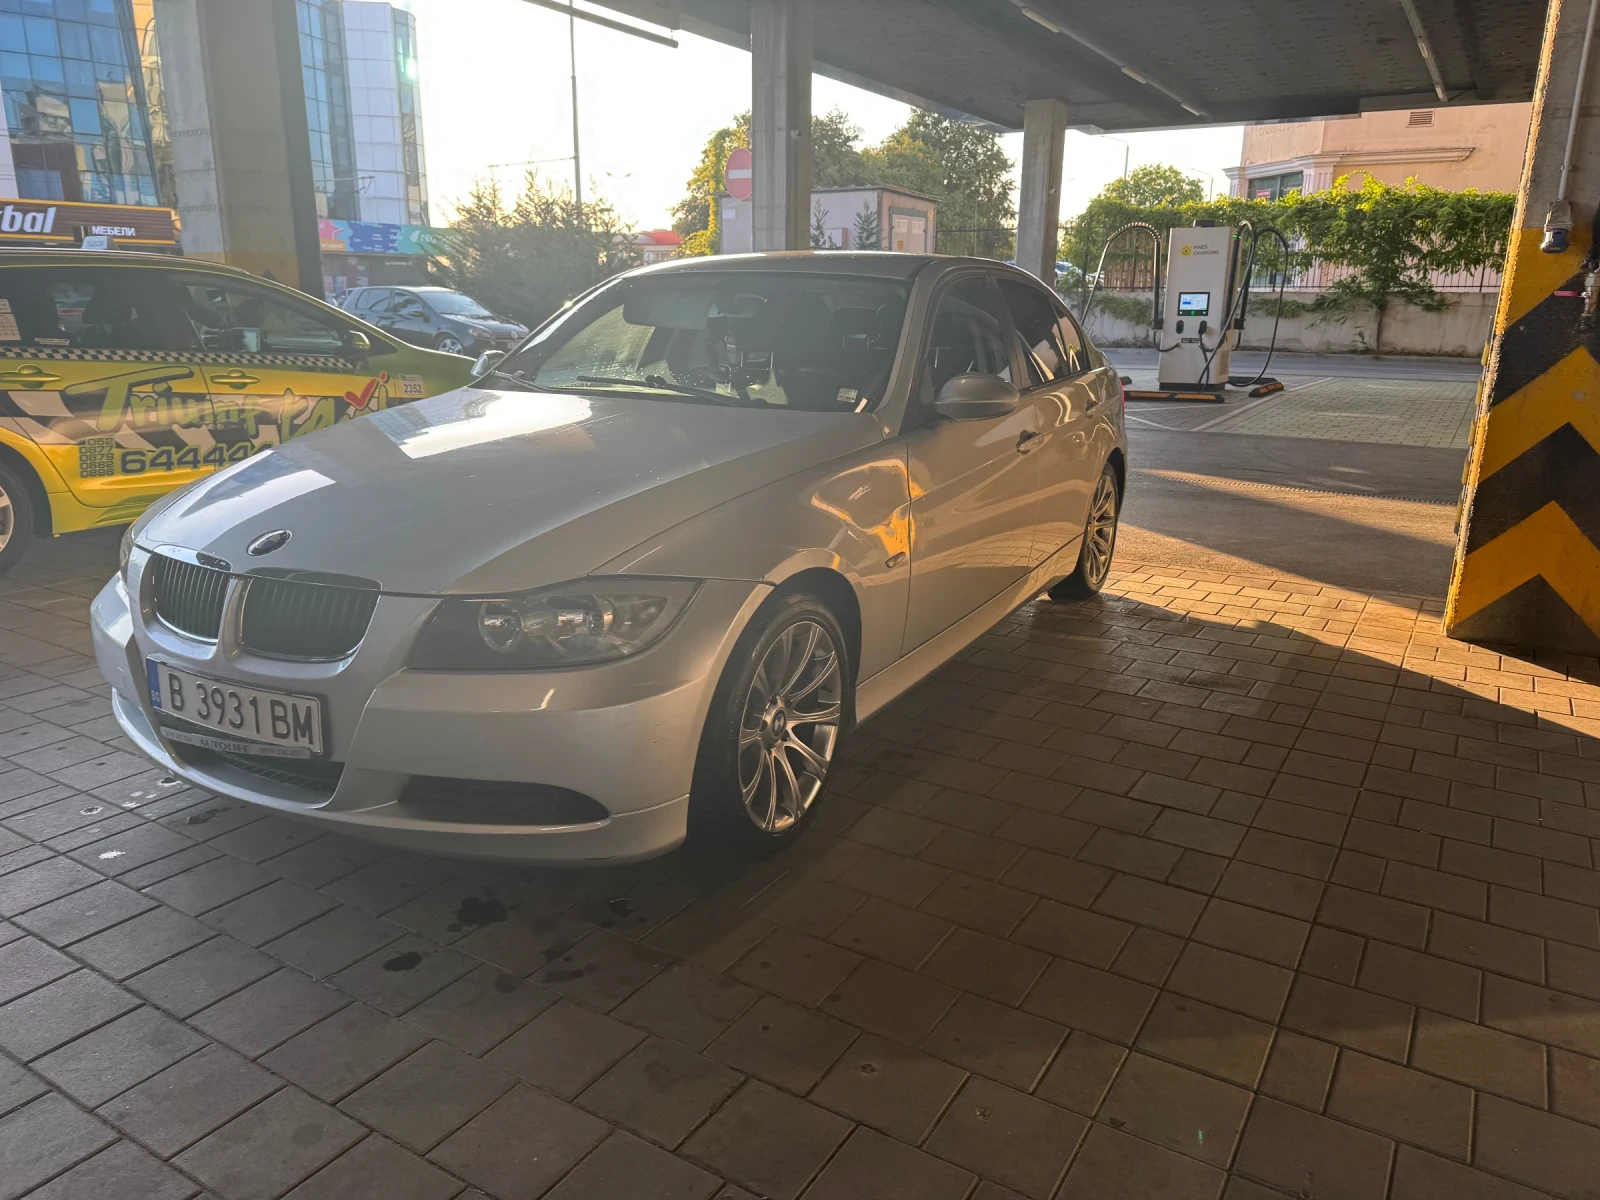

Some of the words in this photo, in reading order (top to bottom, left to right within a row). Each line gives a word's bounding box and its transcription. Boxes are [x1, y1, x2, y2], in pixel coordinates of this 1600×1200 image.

[0, 205, 56, 233] bal
[91, 225, 136, 236] МЕБЕЛИ
[404, 383, 423, 394] 2352
[64, 366, 264, 438] Triumf
[80, 446, 114, 454] 0877
[168, 672, 185, 712] B
[196, 681, 261, 735] 3931
[270, 698, 314, 746] BM
